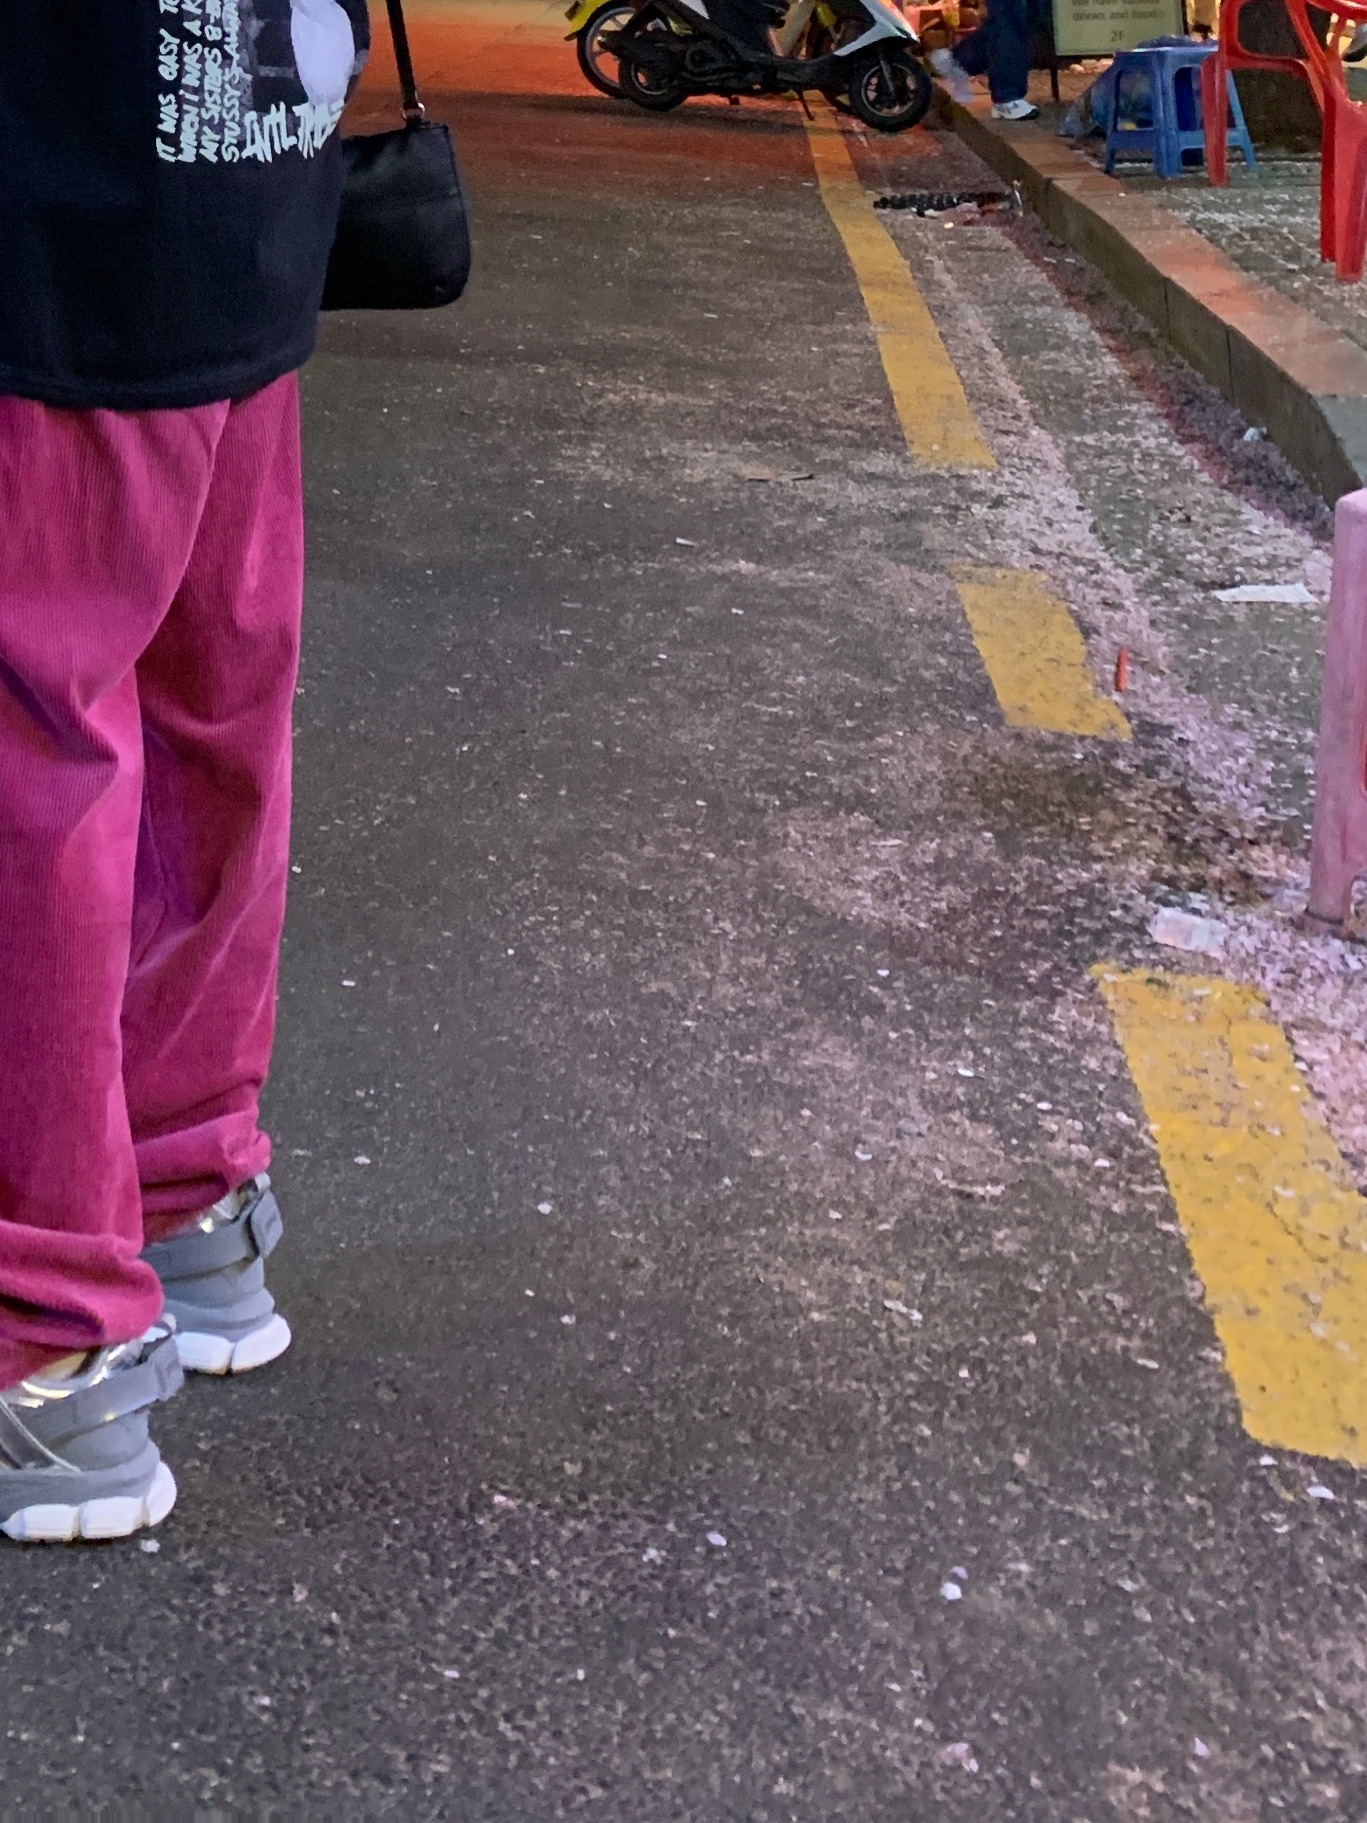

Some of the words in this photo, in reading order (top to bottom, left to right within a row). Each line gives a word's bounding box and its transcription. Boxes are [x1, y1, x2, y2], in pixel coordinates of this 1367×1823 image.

[181, 19, 203, 37] A
[180, 41, 204, 88] WAS
[156, 92, 180, 134] WAS
[155, 135, 177, 163] IT
[198, 125, 222, 164] MY
